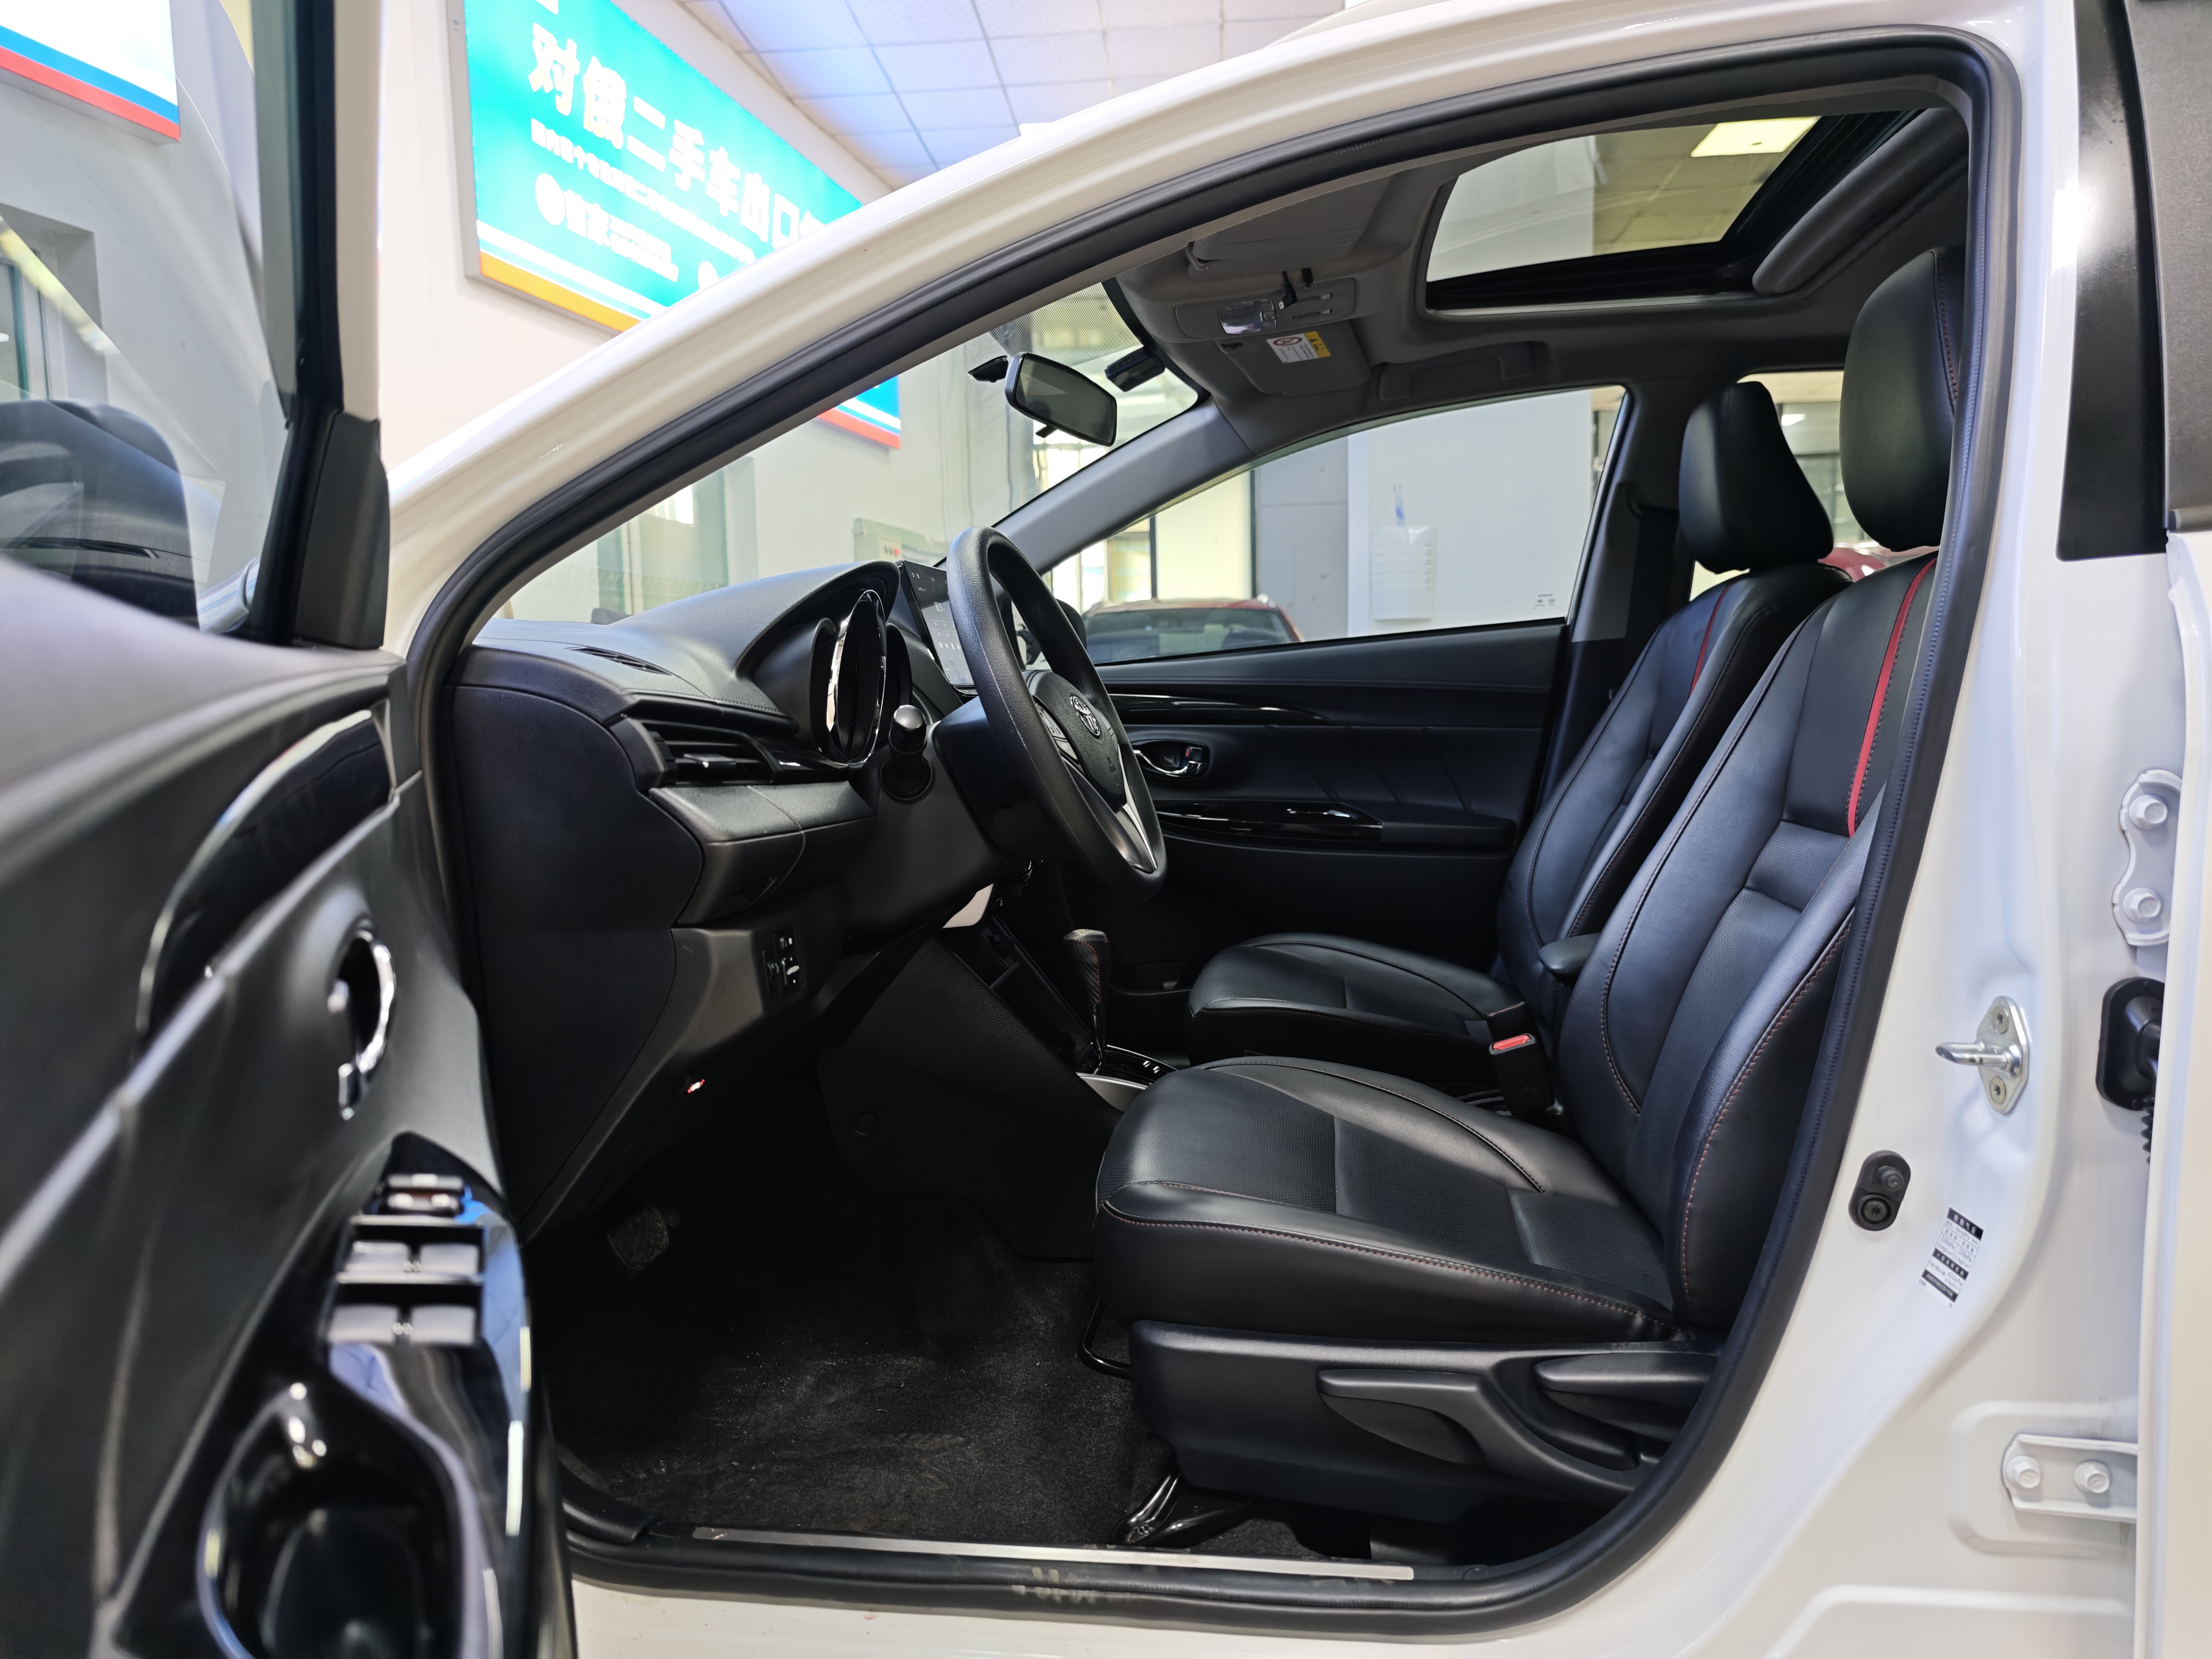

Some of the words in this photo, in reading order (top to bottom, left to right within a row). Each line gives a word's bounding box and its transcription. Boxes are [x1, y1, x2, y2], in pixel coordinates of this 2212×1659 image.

[1954, 1214, 1976, 1234] 轮胎气压
[1941, 1236, 1954, 1250] 230kPa
[1958, 1248, 1972, 1262] 220kPa
[1947, 1271, 1962, 1286] 420kPa
